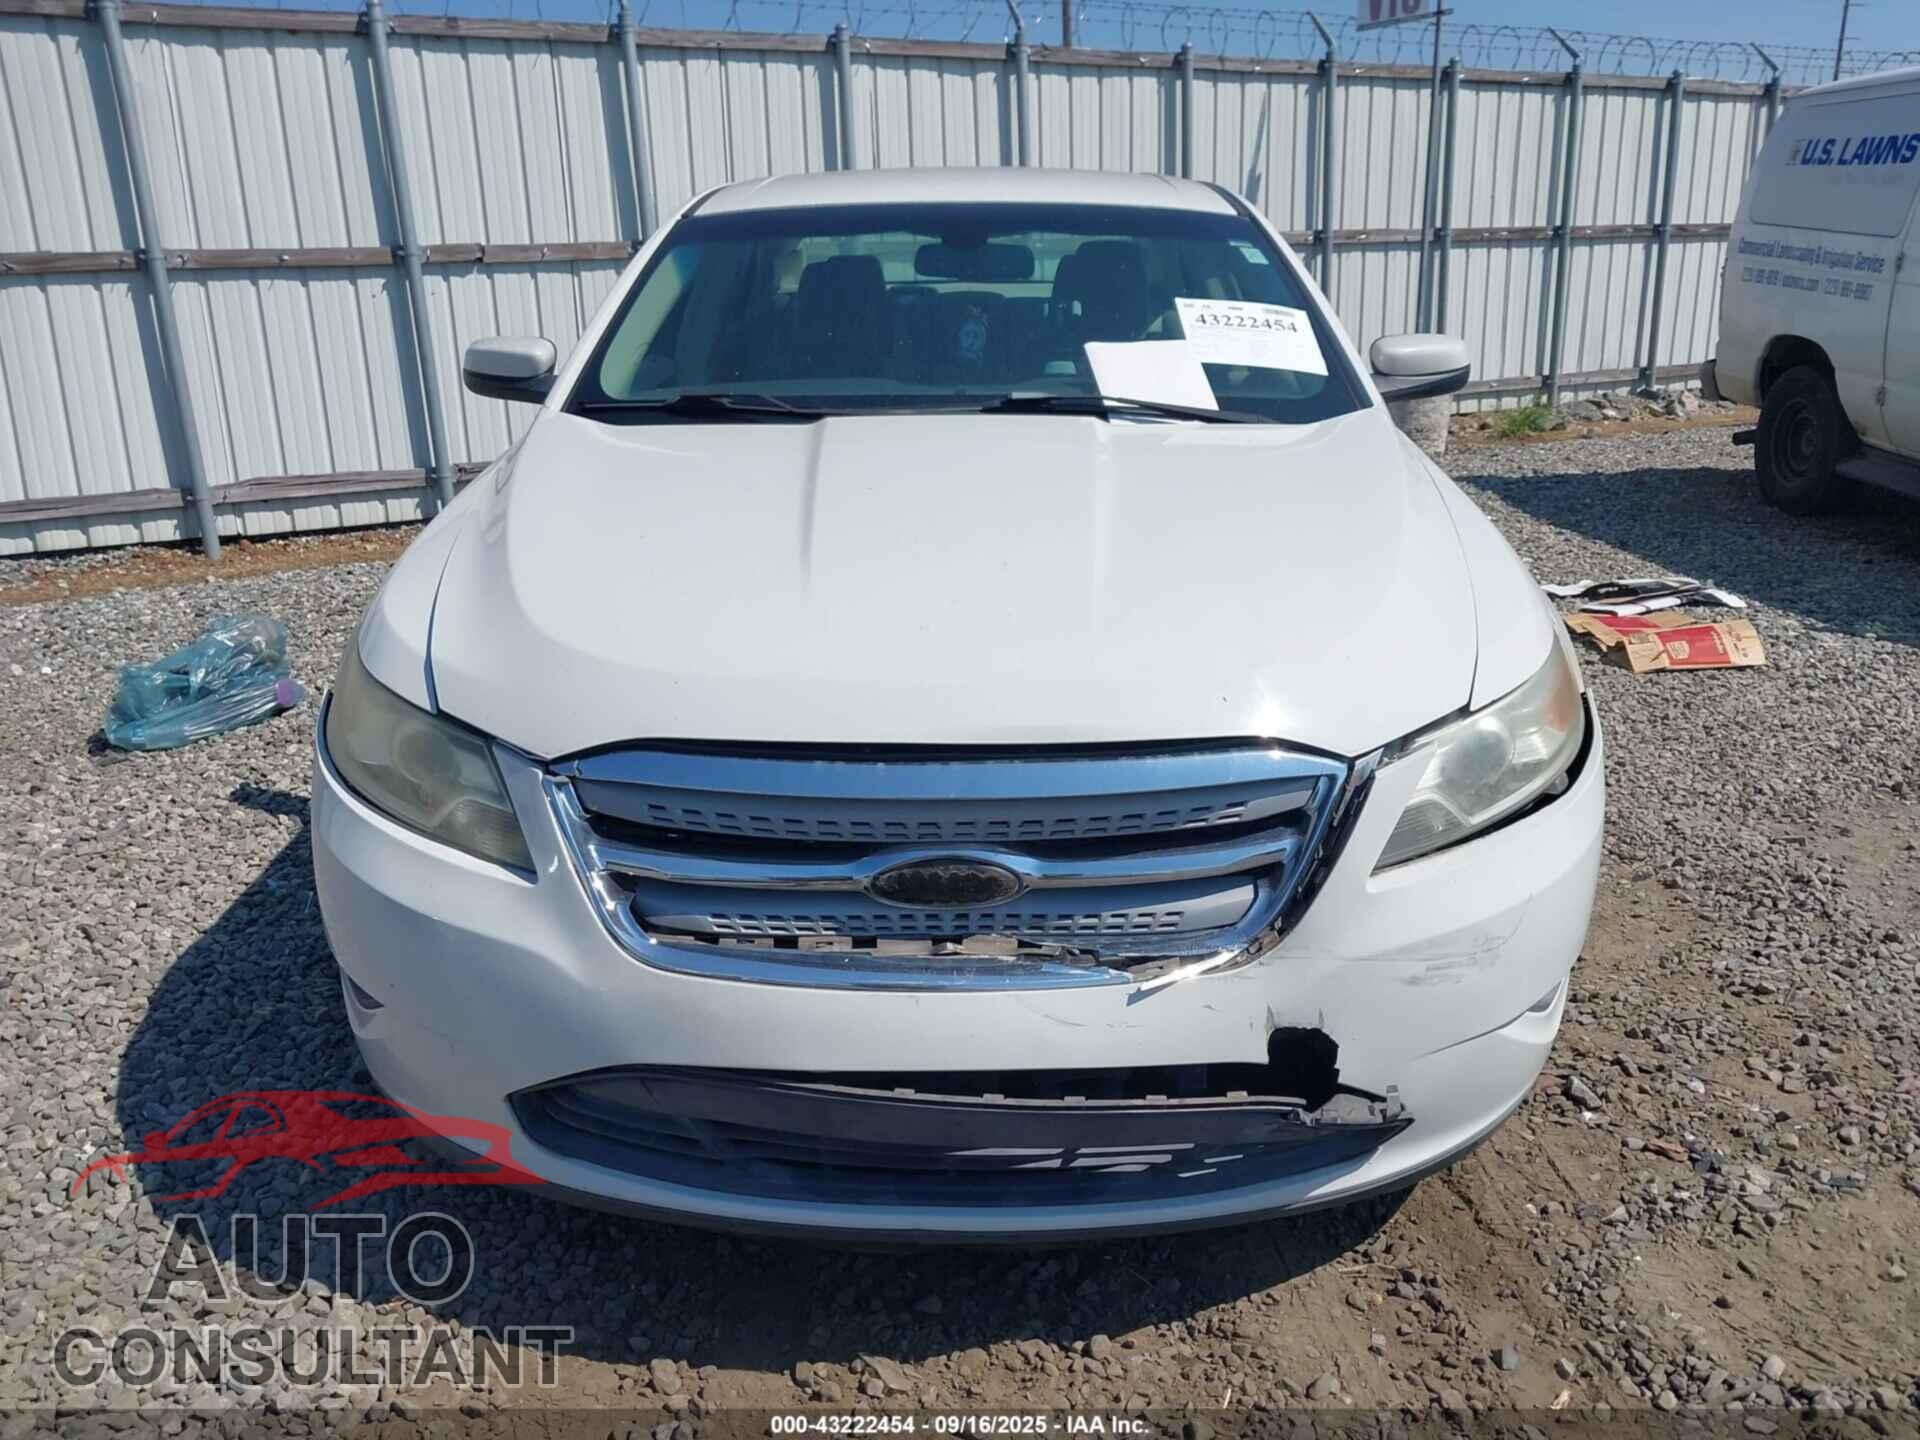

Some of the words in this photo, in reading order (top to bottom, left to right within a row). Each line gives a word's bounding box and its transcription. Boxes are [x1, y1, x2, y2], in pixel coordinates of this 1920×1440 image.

[1801, 138, 1835, 166] U.S.
[1837, 133, 1920, 165] LAWNS
[1195, 313, 1299, 333] 43222454
